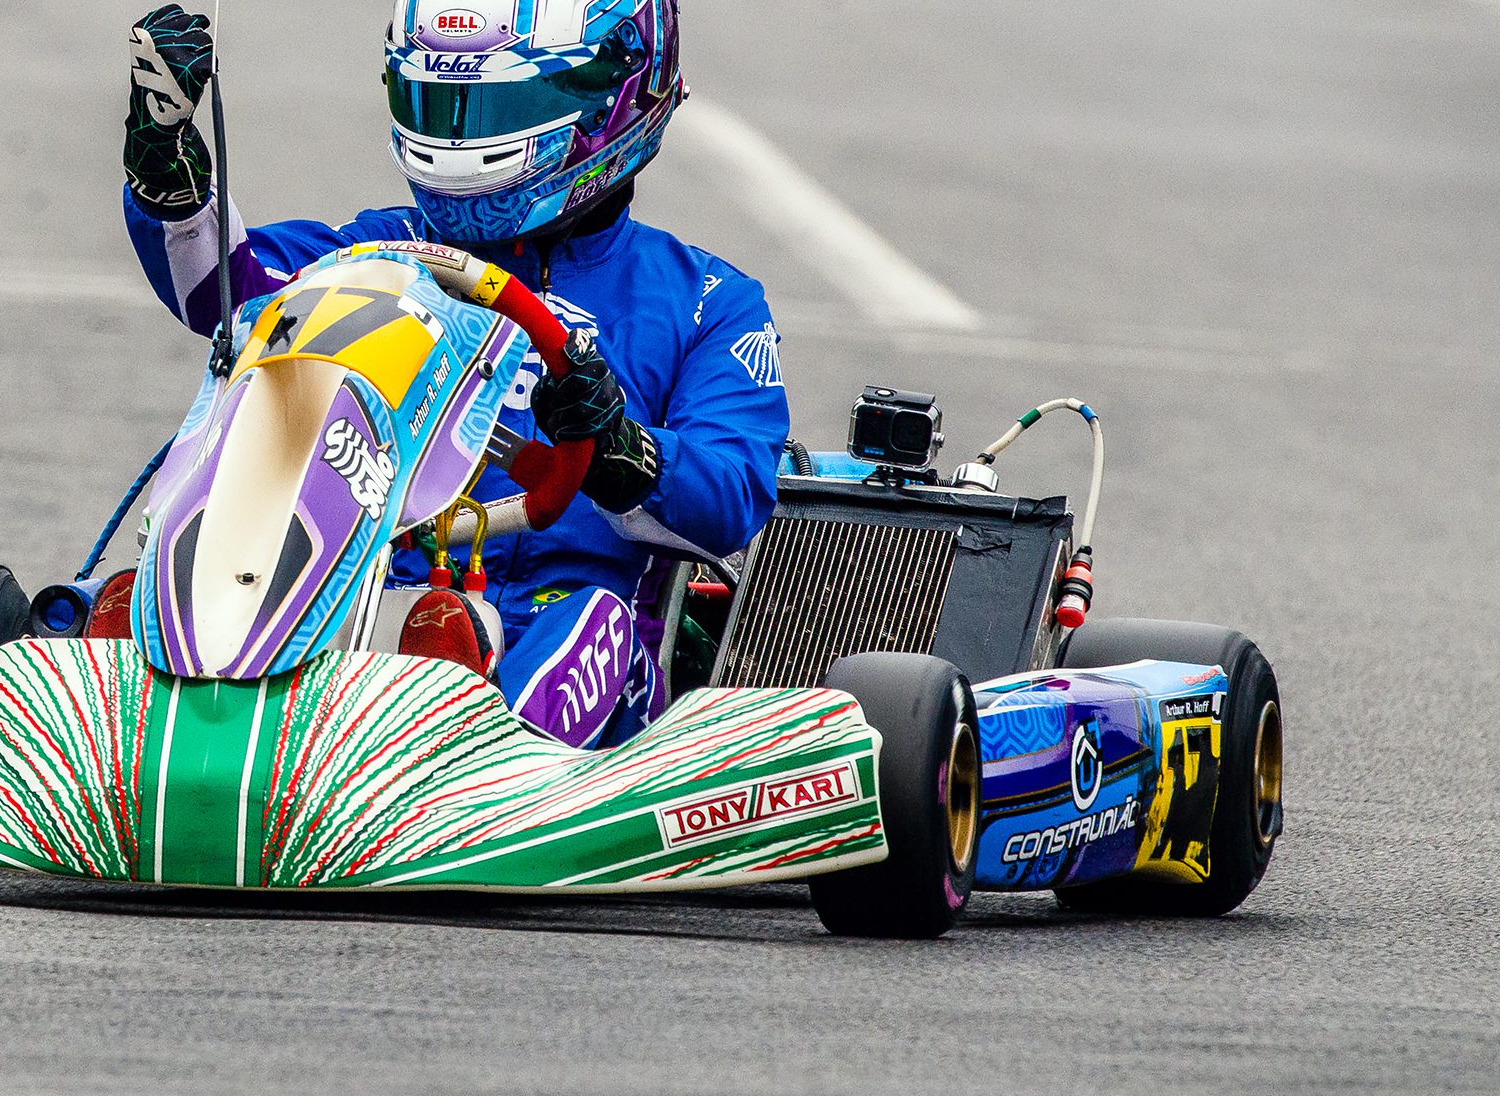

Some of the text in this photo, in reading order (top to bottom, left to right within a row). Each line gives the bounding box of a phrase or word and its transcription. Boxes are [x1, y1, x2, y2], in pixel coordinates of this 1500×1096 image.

[437, 15, 478, 29] BELL
[257, 286, 410, 361] 17
[408, 350, 451, 443] Arthur R. Hoff
[1166, 700, 1210, 717] Arthur R. Hoff
[664, 766, 849, 835] TONY KART
